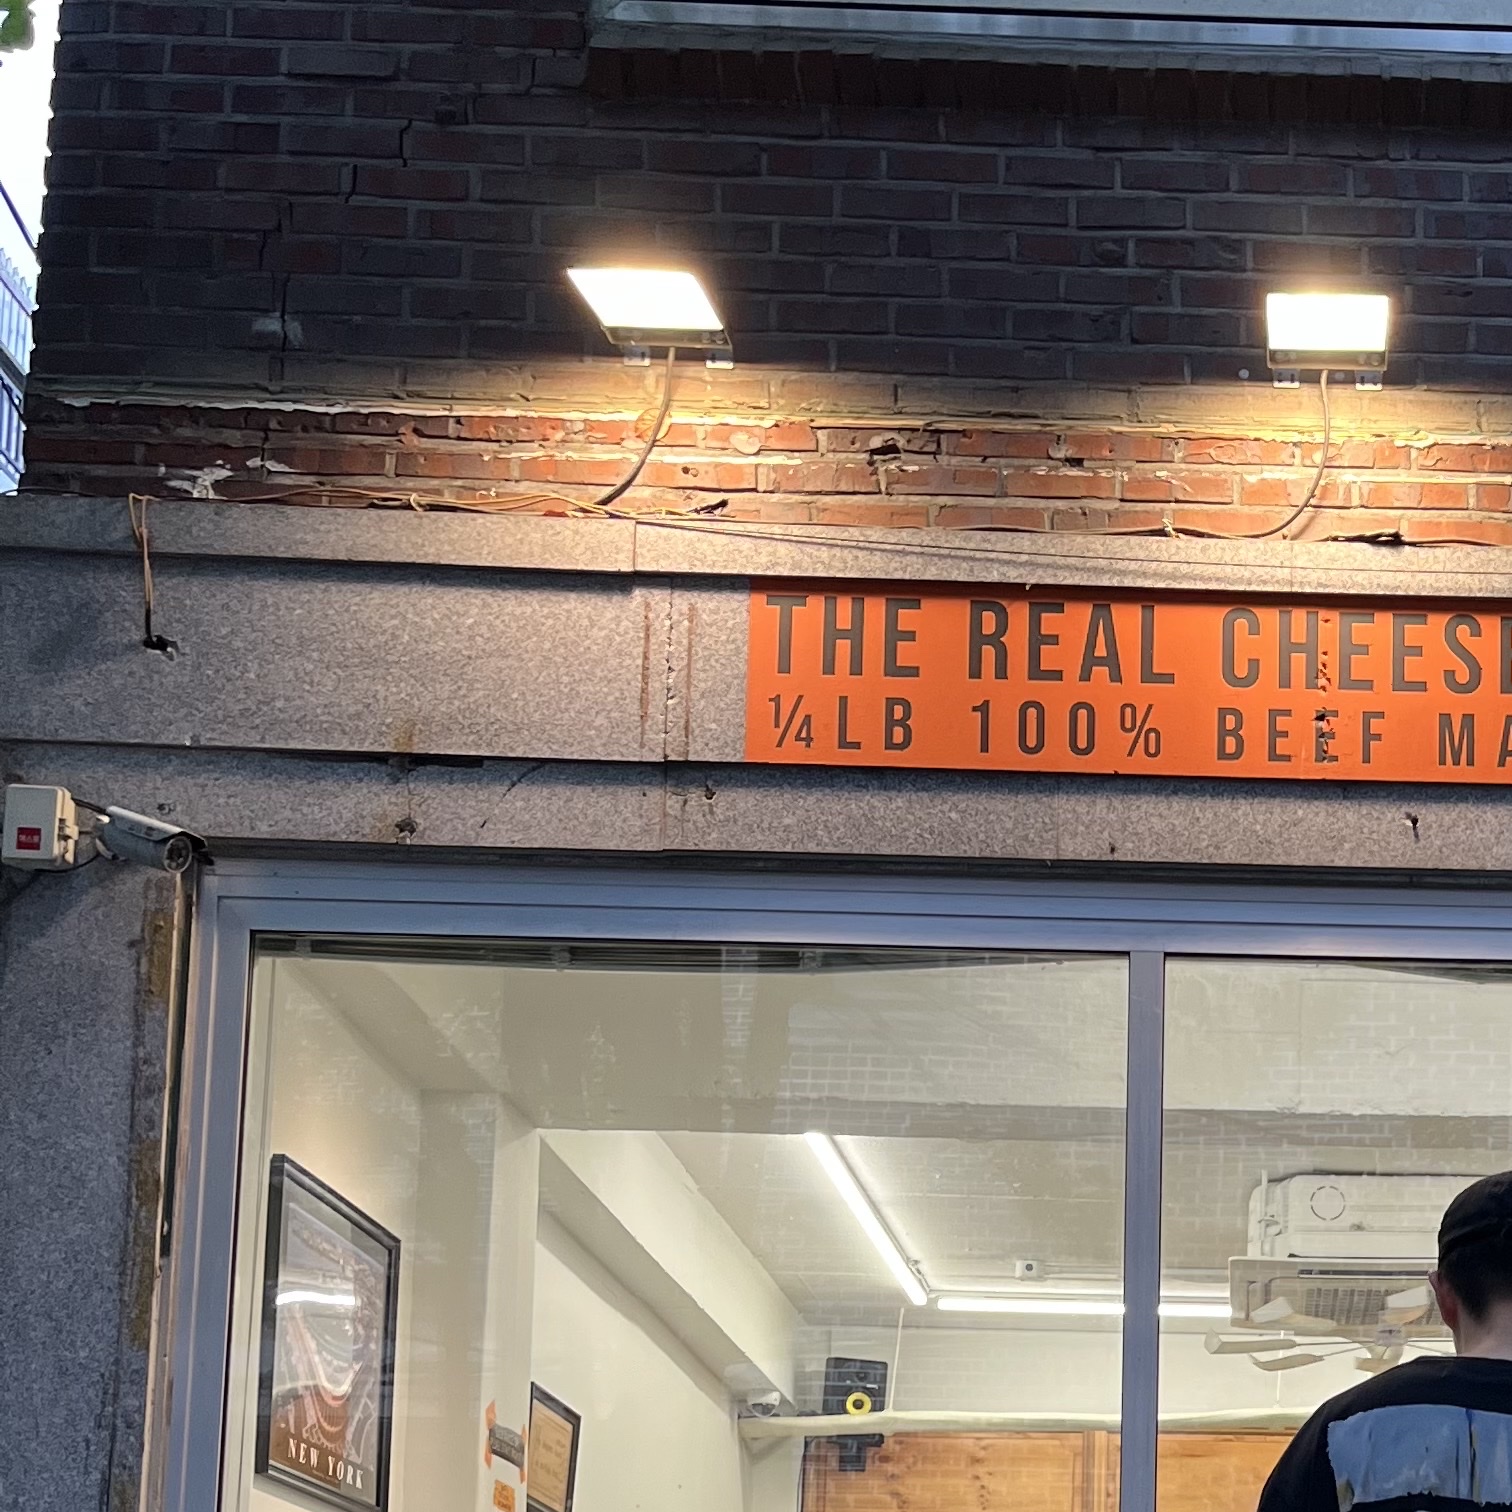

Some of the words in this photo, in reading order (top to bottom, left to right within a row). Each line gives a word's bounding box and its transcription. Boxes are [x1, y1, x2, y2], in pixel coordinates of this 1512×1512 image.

[766, 594, 922, 679] THE
[968, 600, 1175, 685] REAL
[971, 700, 1162, 758] 100%
[1217, 707, 1386, 764] BEEF
[287, 1438, 320, 1468] NEW
[327, 1455, 364, 1490] YORK
